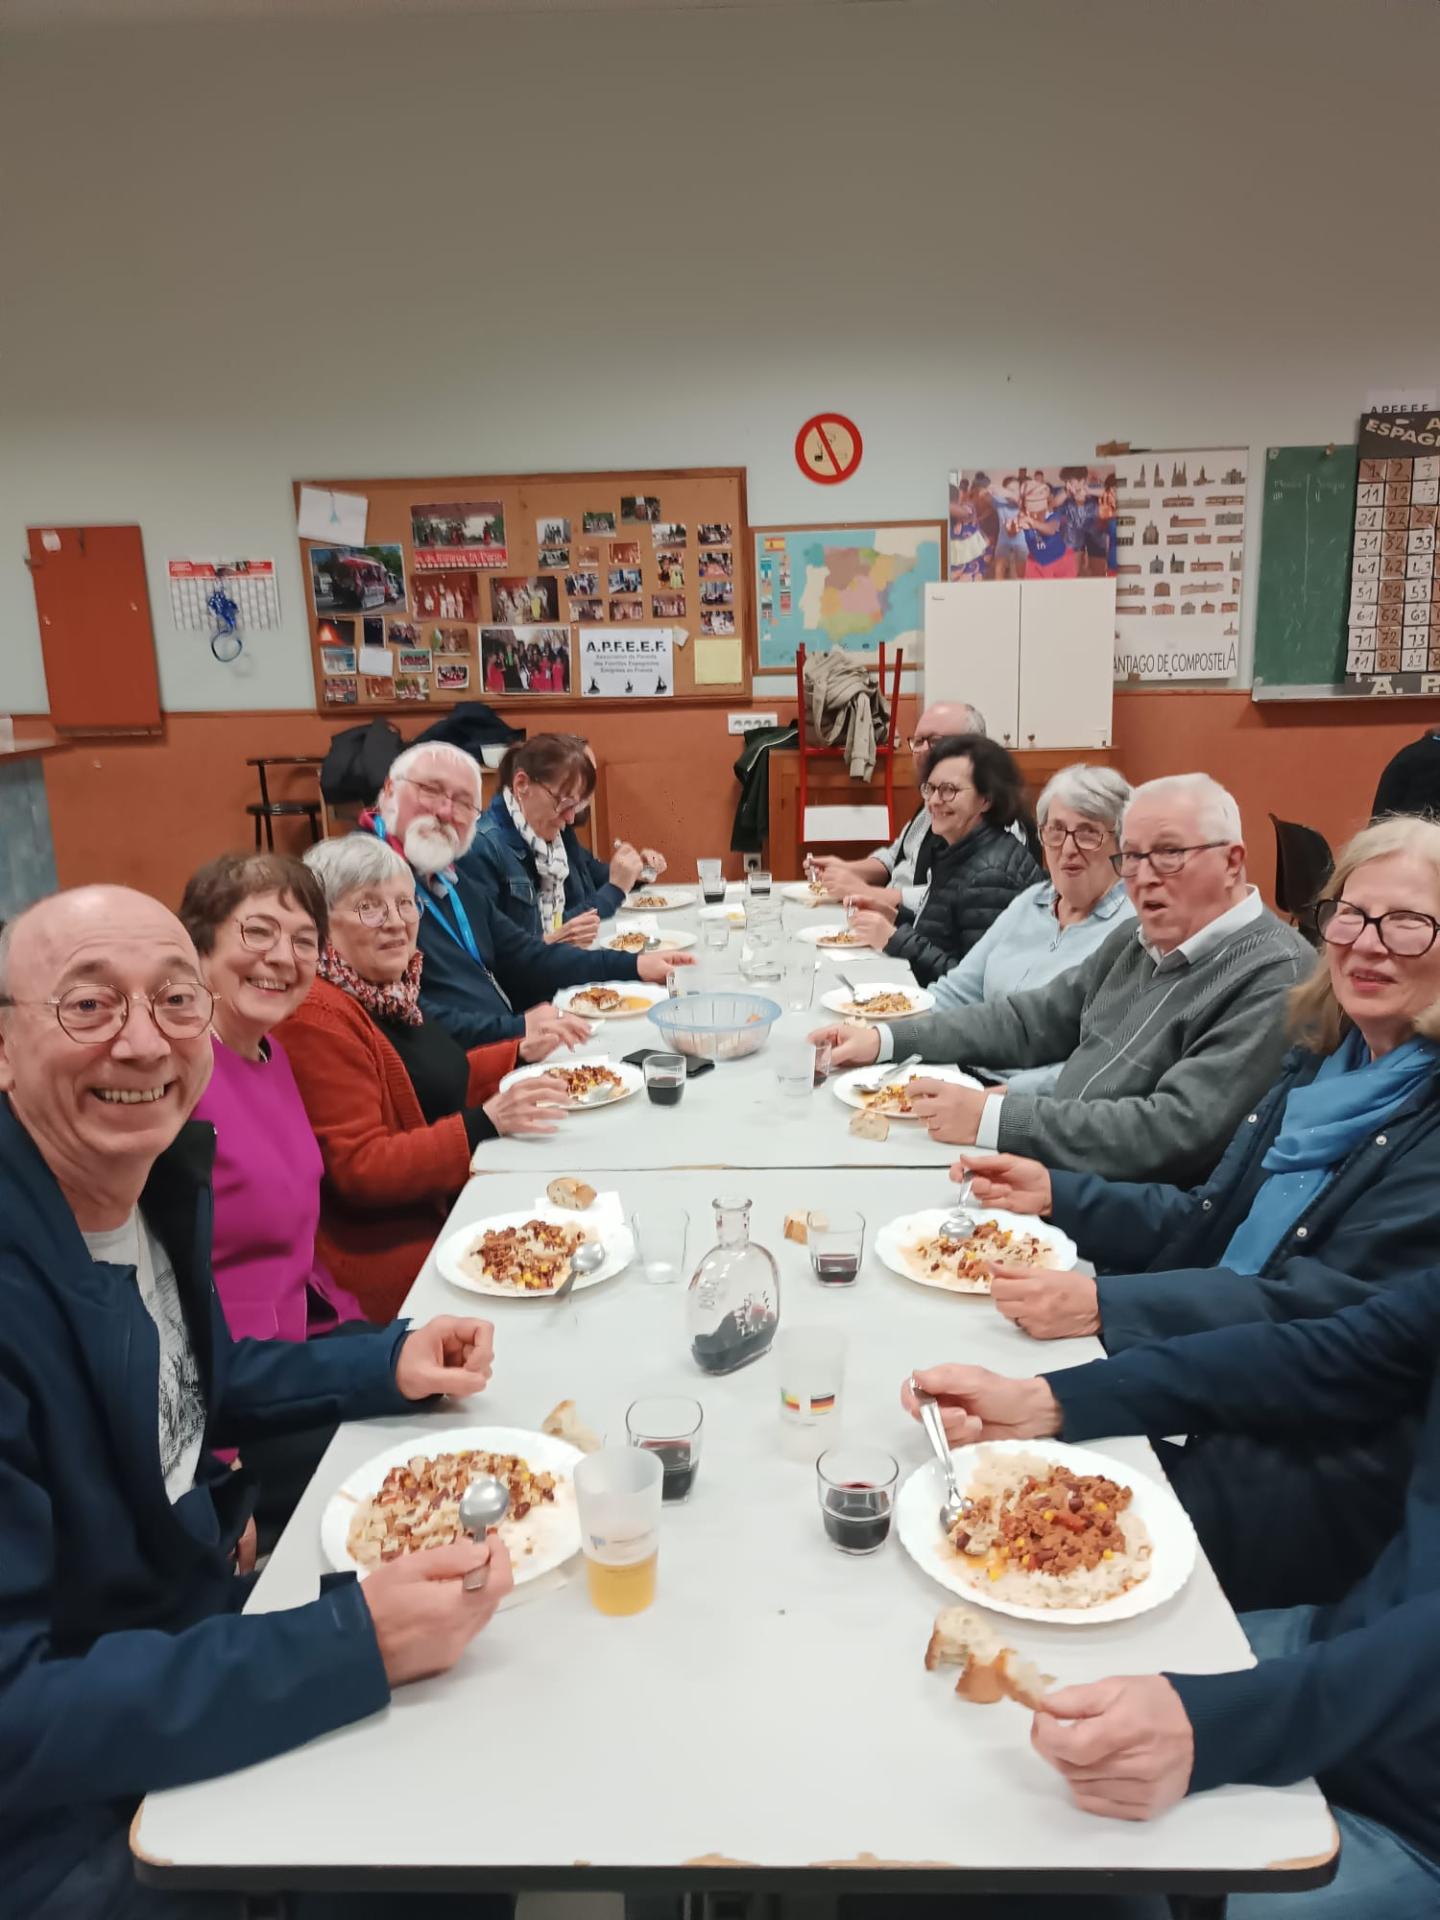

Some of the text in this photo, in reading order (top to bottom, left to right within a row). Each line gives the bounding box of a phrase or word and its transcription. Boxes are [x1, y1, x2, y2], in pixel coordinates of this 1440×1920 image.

[1361, 488, 1380, 503] 11
[1389, 511, 1406, 526] 22
[1358, 537, 1378, 552] 31
[1414, 535, 1433, 550] 33
[1357, 586, 1373, 599] 51
[1383, 583, 1401, 598] 52
[1410, 584, 1428, 599] 53
[1381, 608, 1398, 622] 62
[1410, 608, 1427, 623] 63
[586, 640, 667, 653] A.P.F.E.E.F.
[1354, 632, 1372, 648] 71
[1381, 632, 1398, 647] 72
[1408, 633, 1425, 647] 73
[1113, 642, 1236, 673] ANTIAGO DE COMPOSTELA
[1379, 653, 1398, 668] 82
